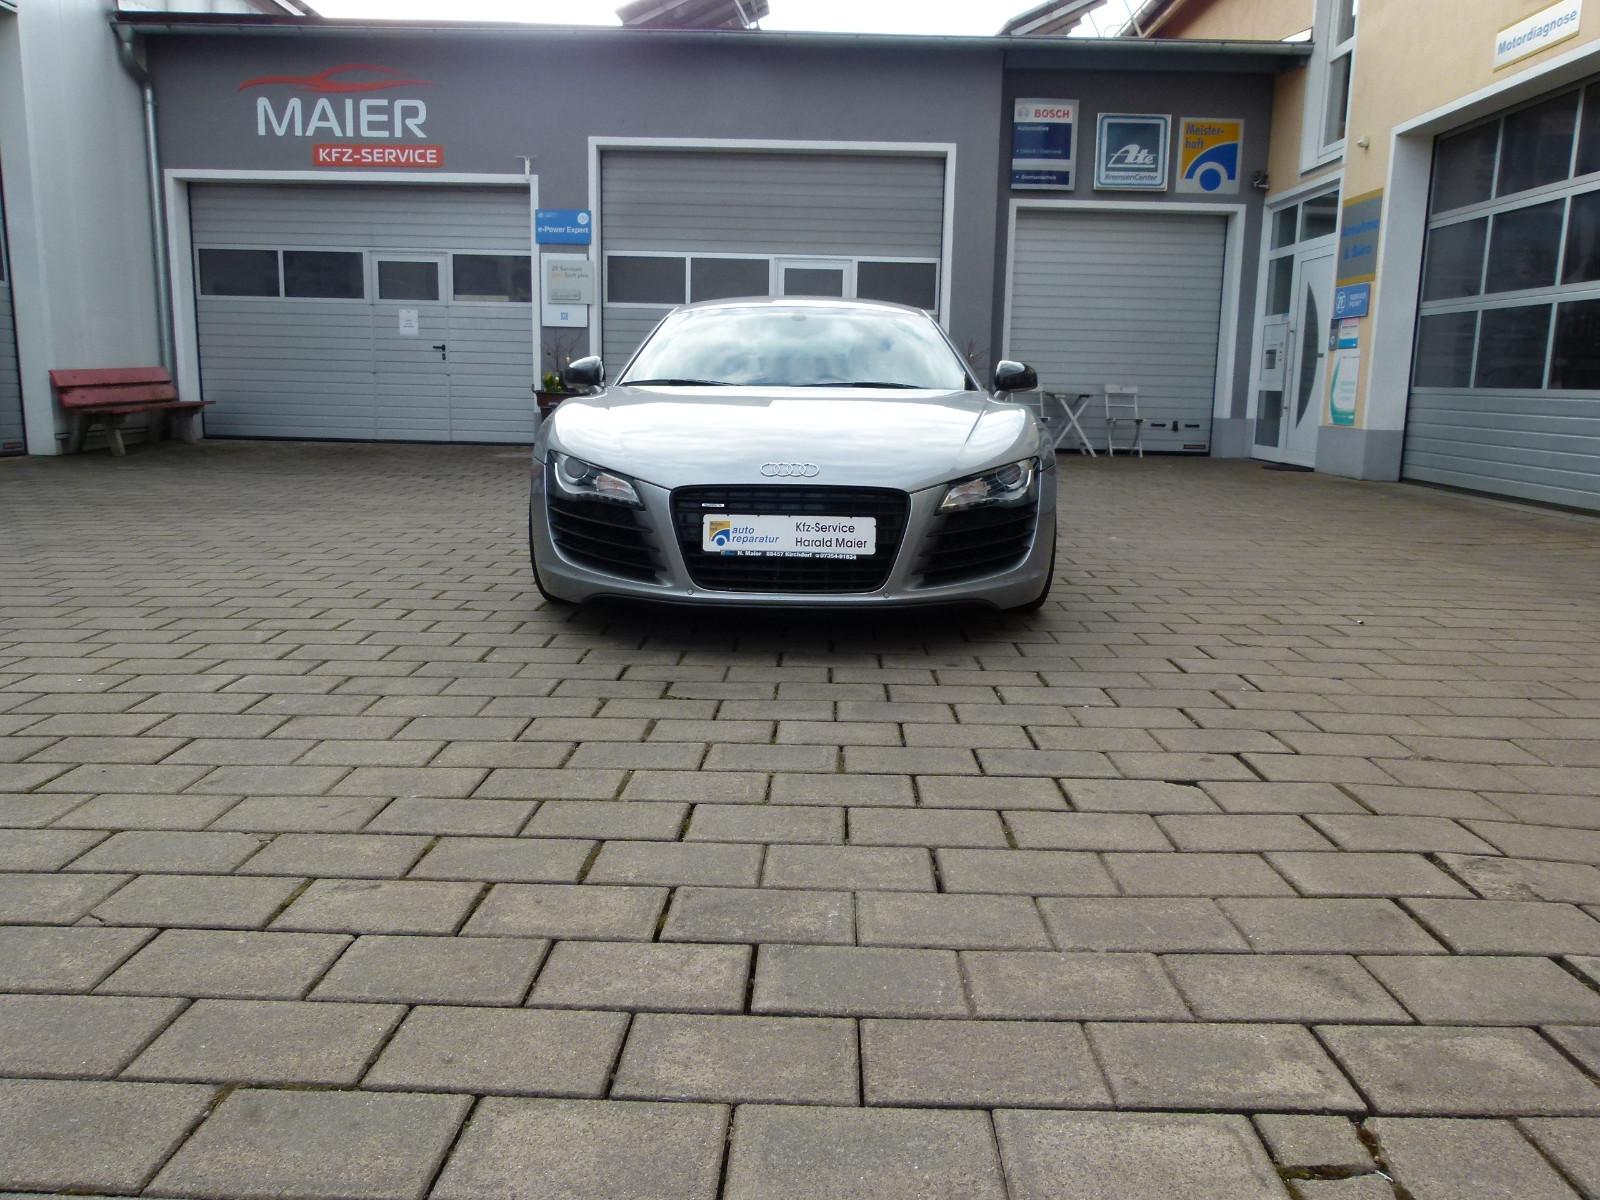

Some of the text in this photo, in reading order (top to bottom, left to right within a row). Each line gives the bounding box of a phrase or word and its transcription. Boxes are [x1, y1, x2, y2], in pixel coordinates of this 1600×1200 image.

[1497, 10, 1577, 56] Motordiagnose
[256, 96, 428, 139] MAIER
[1033, 109, 1070, 119] BOSCH
[1185, 122, 1225, 136] Meister-
[1185, 137, 1204, 149] haft
[319, 148, 438, 163] KFZ-SERVICE
[537, 225, 589, 235] e-Power Expert
[732, 526, 755, 535] auto
[795, 522, 856, 533] Kfz-Service
[732, 535, 780, 545] reparatur
[795, 537, 868, 549] Harald Maier
